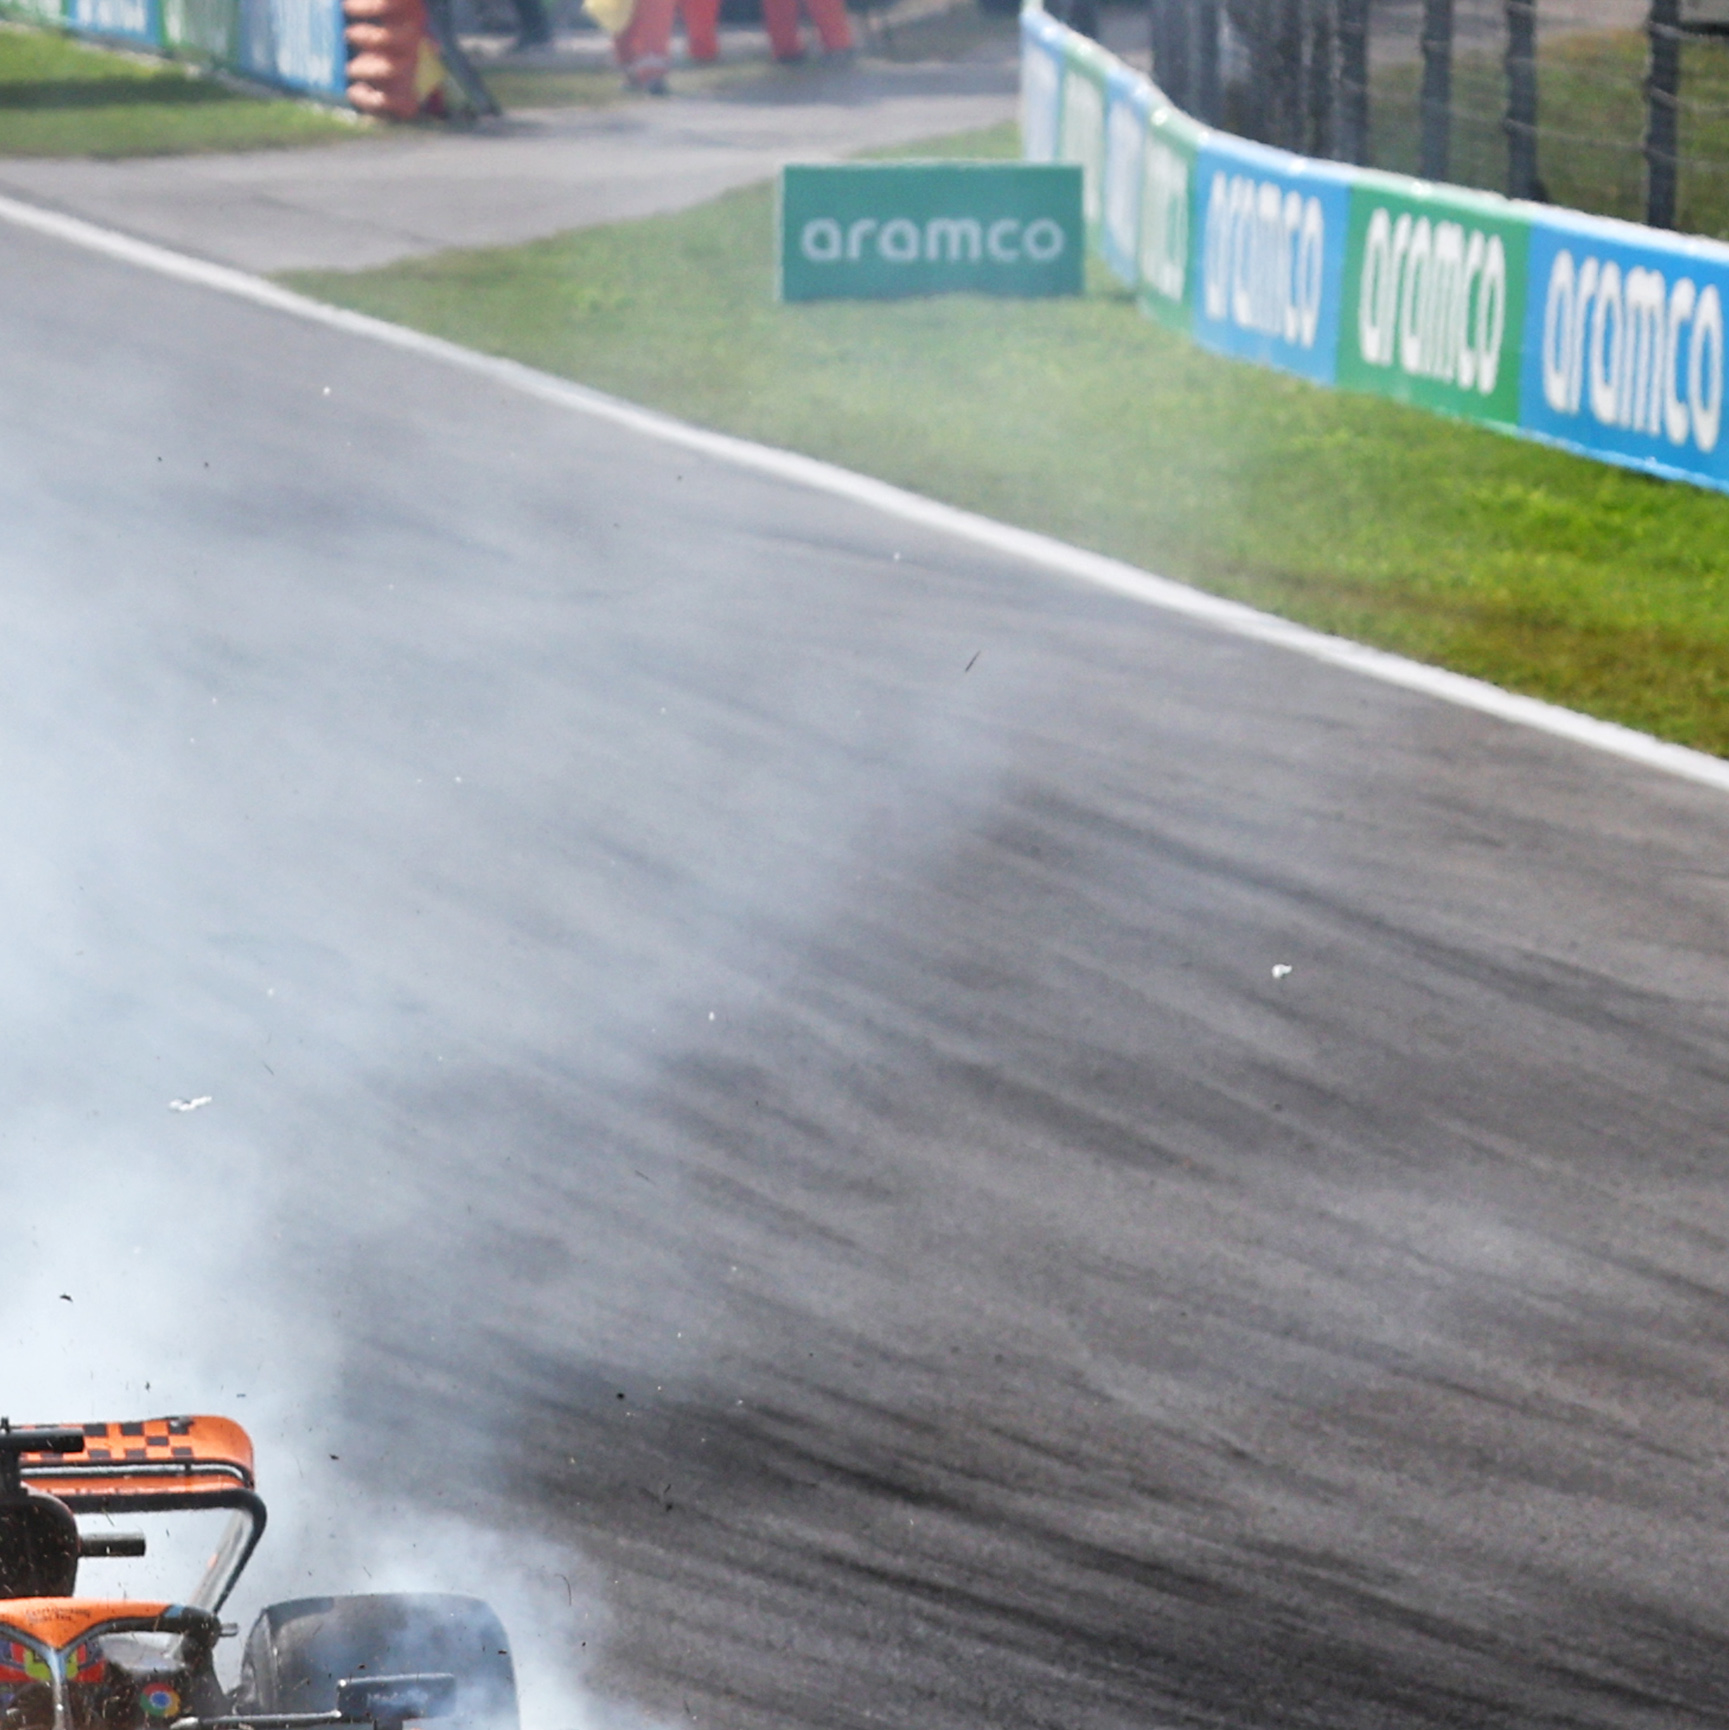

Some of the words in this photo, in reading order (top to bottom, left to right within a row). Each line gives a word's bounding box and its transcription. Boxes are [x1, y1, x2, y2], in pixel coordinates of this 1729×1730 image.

[801, 216, 1065, 262] aramco
[1358, 207, 1506, 396] aramco
[1542, 249, 1724, 453] aramco
